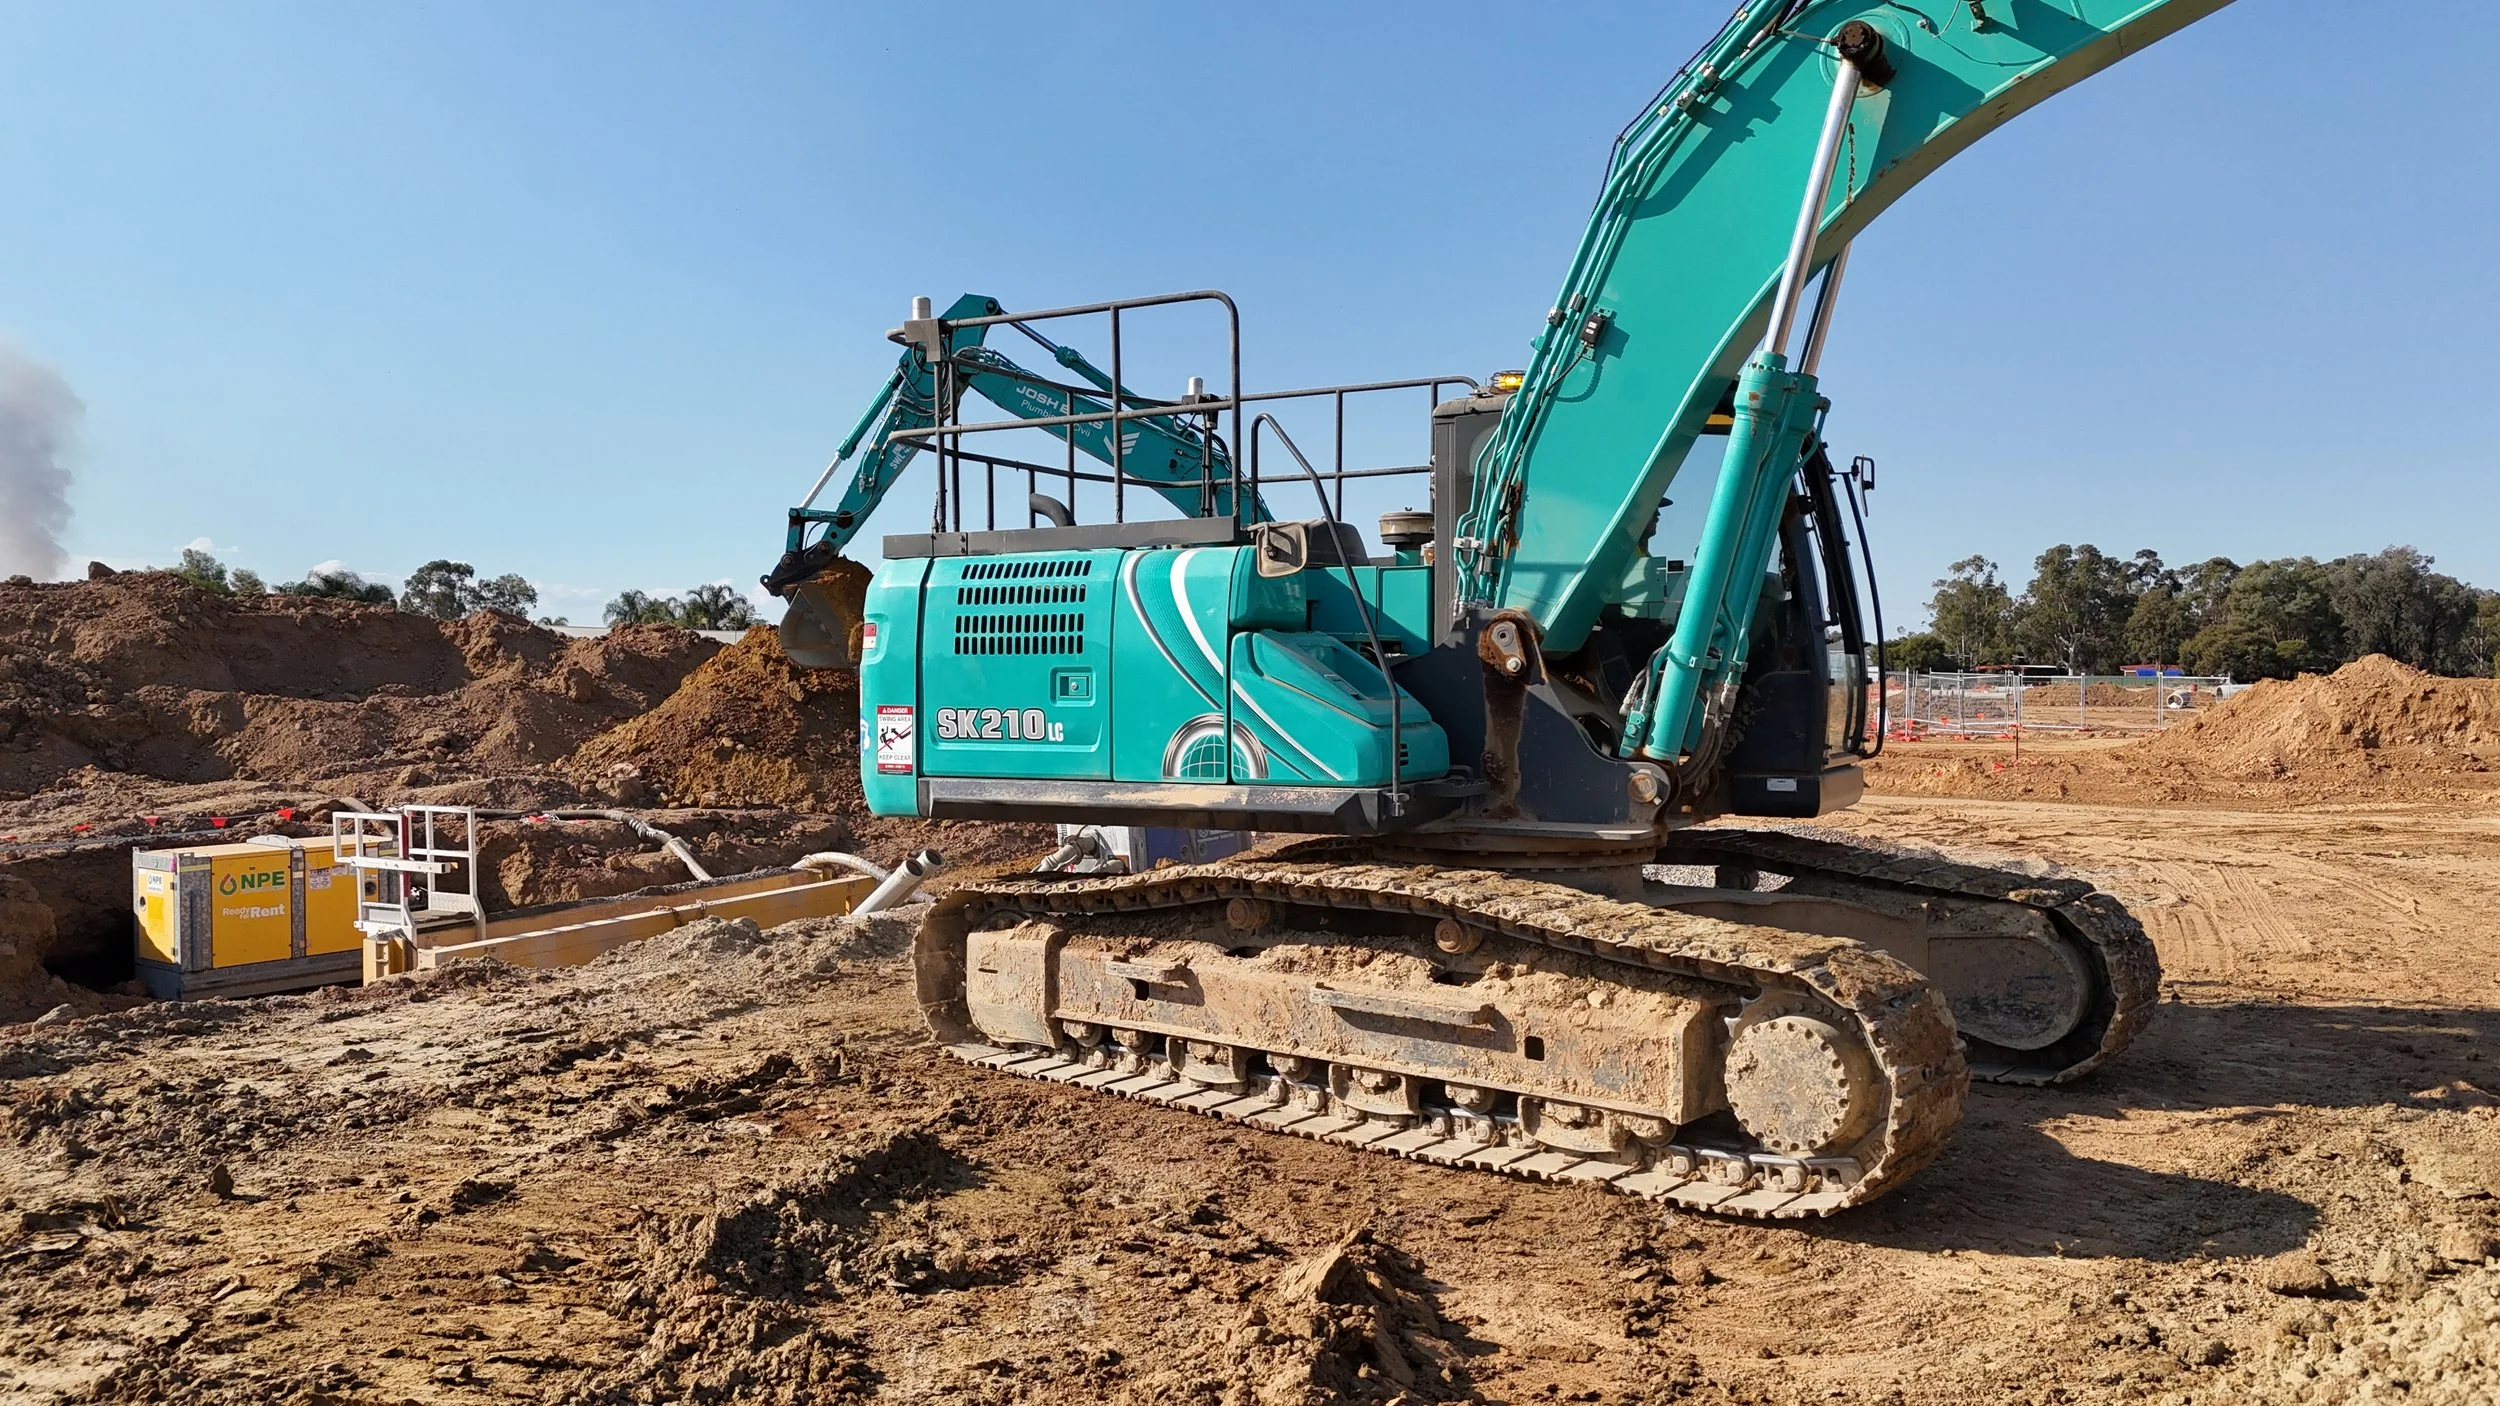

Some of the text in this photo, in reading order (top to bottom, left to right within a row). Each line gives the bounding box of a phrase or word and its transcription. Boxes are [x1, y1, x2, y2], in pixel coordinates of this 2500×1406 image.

[1016, 385, 1059, 409] JOSH
[1073, 423, 1091, 437] Civil
[889, 453, 906, 470] SWL
[937, 708, 1064, 741] SK210 LC
[241, 871, 285, 889] NPE
[222, 906, 250, 916] Ready
[250, 904, 285, 918] Rent
